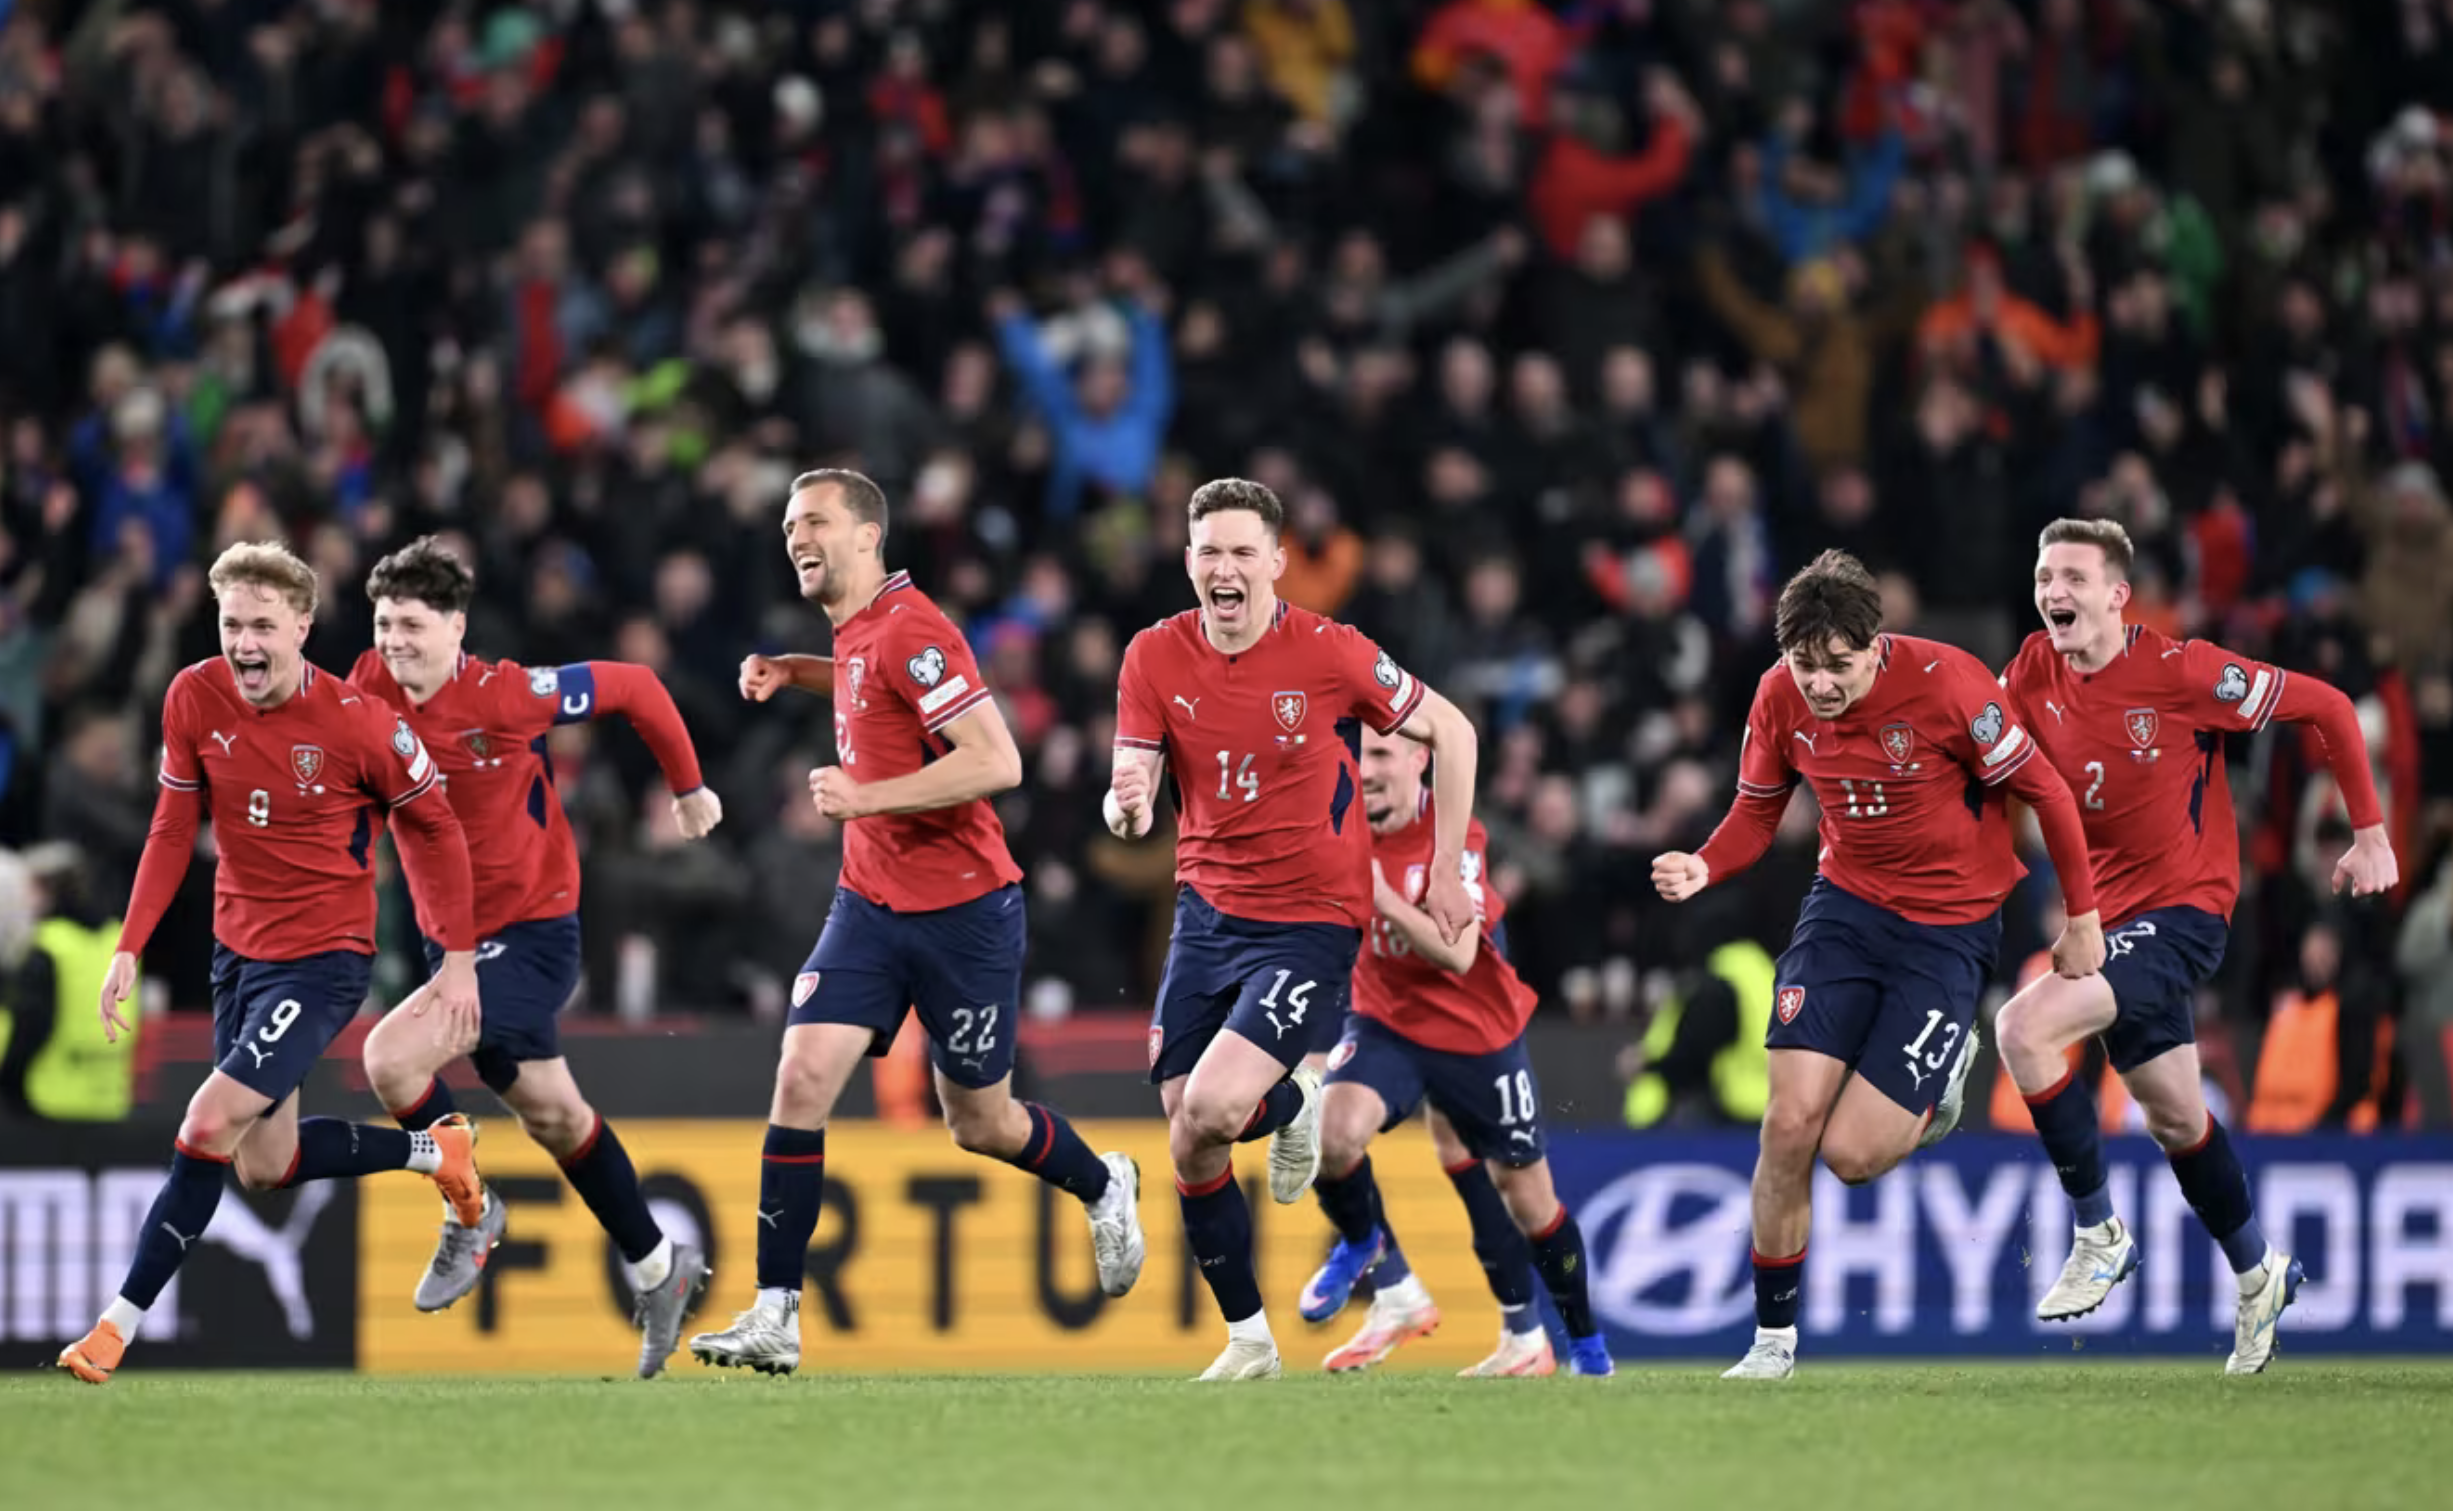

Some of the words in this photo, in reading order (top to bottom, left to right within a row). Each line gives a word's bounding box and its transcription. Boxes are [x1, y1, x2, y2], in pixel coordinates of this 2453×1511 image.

[563, 691, 590, 715] C
[1216, 750, 1260, 802] 14
[2084, 761, 2105, 811] 2
[248, 788, 269, 828] 9
[259, 998, 302, 1043] 9
[1258, 968, 1317, 1025] 14
[948, 1003, 998, 1054] 22
[1902, 1008, 1961, 1071] 13
[1494, 1068, 1536, 1126] 18
